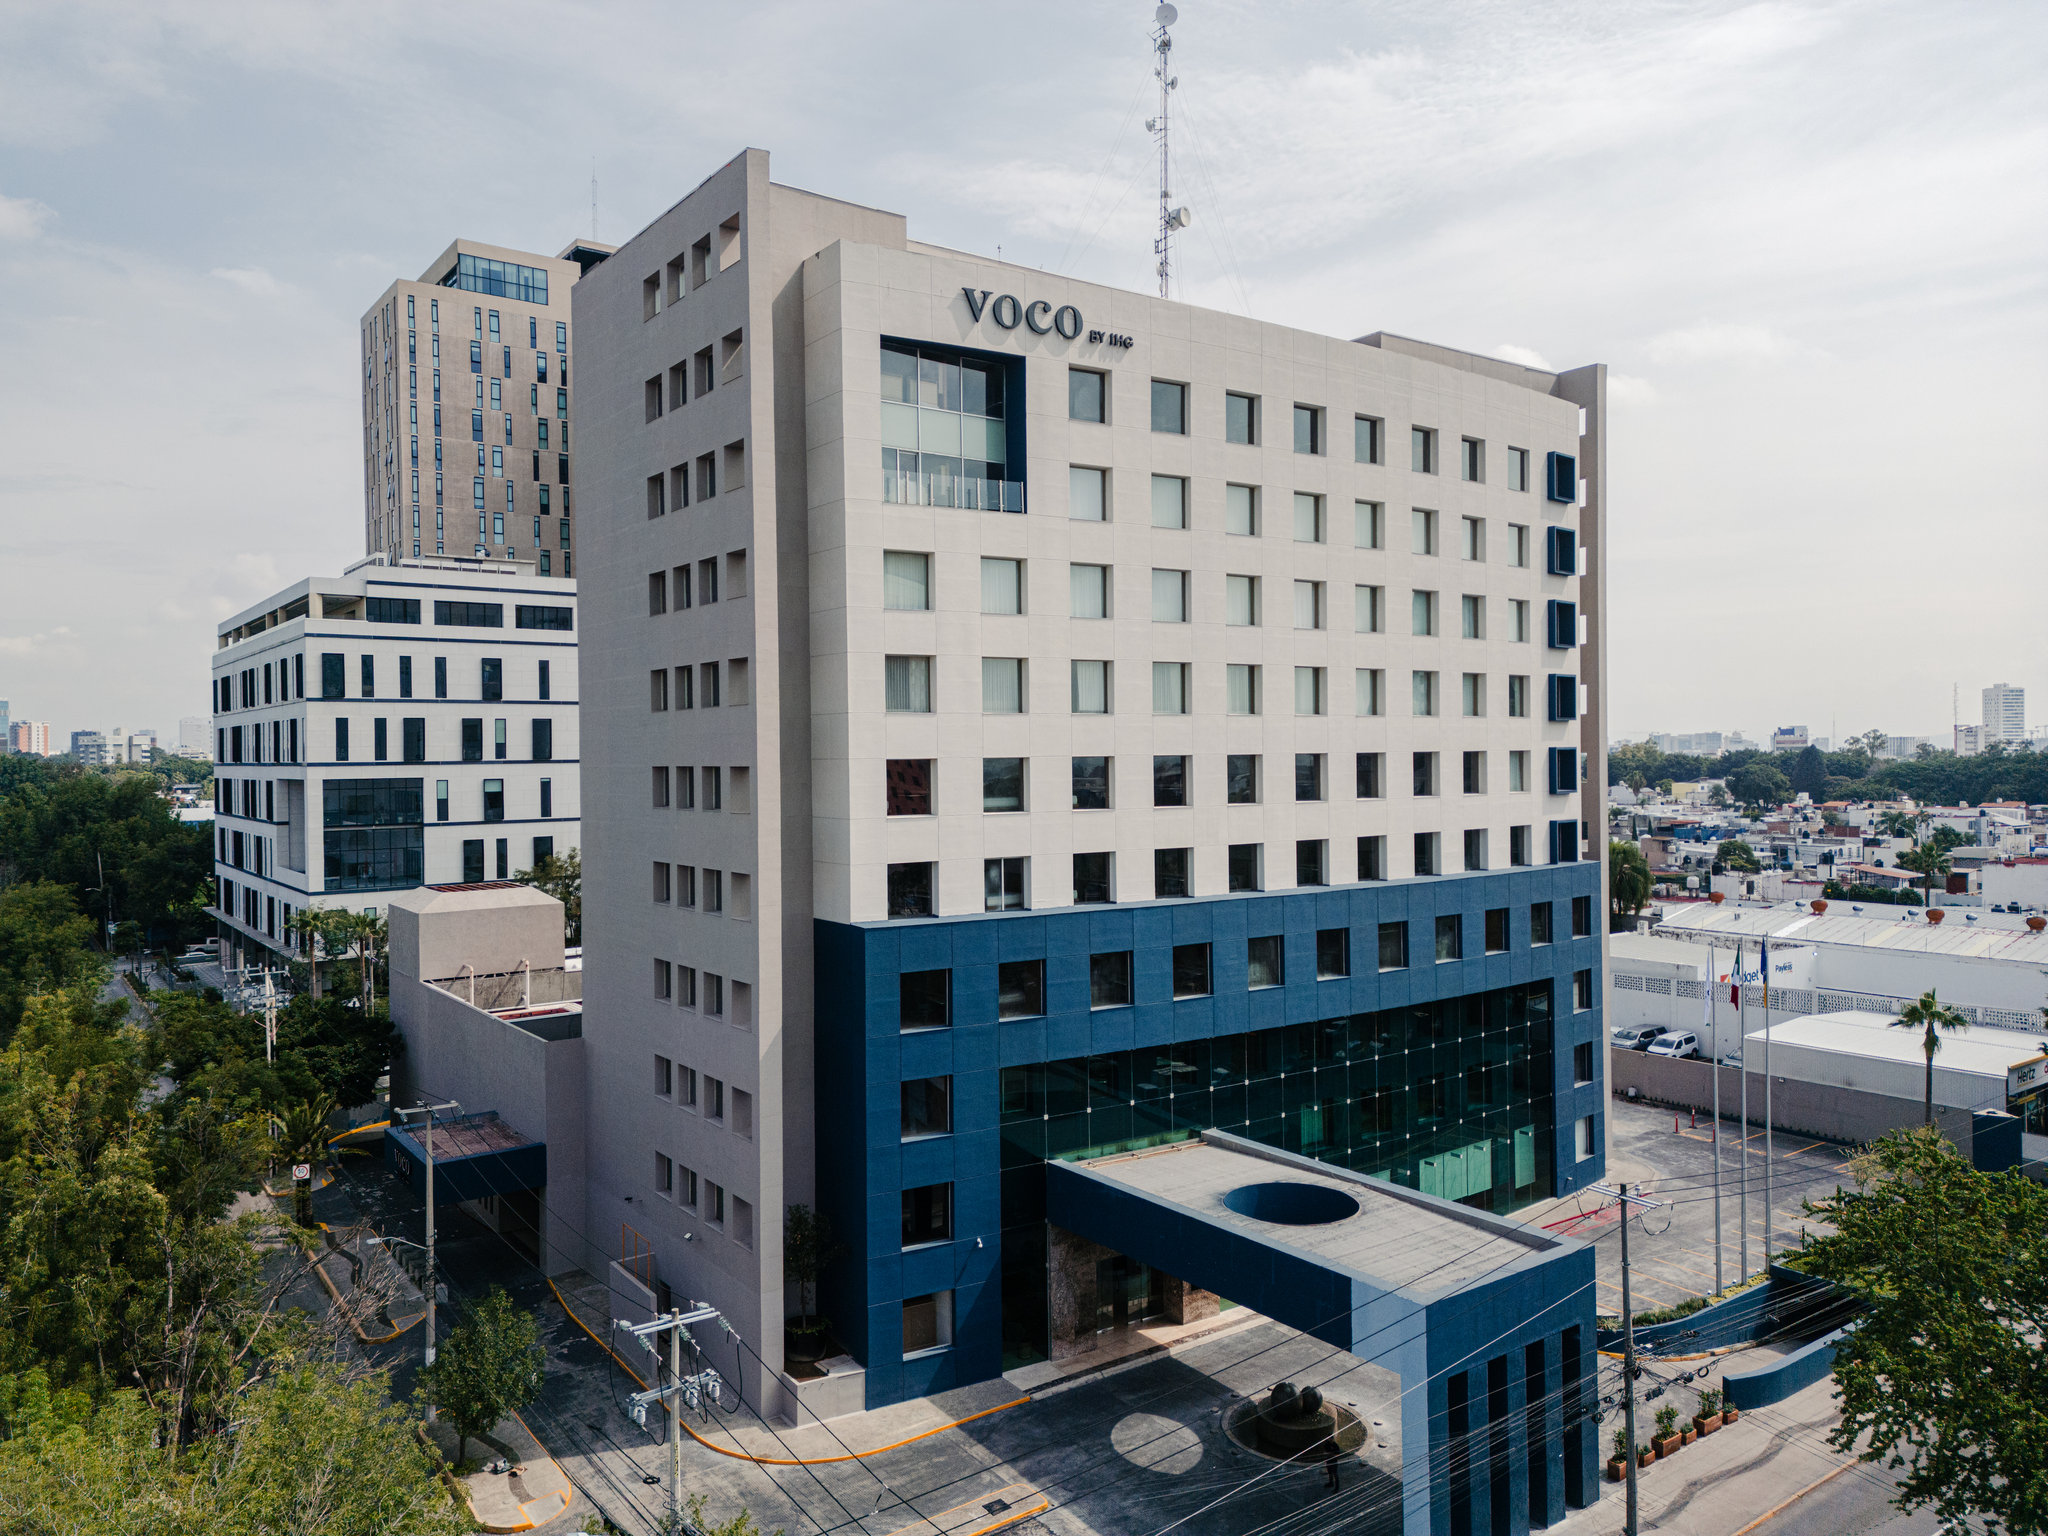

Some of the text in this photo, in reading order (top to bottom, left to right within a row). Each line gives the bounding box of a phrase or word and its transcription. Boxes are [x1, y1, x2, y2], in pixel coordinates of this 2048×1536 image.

[1089, 330, 1106, 344] BY
[1109, 333, 1134, 349] IHG
[2017, 1068, 2035, 1083] Hertz
